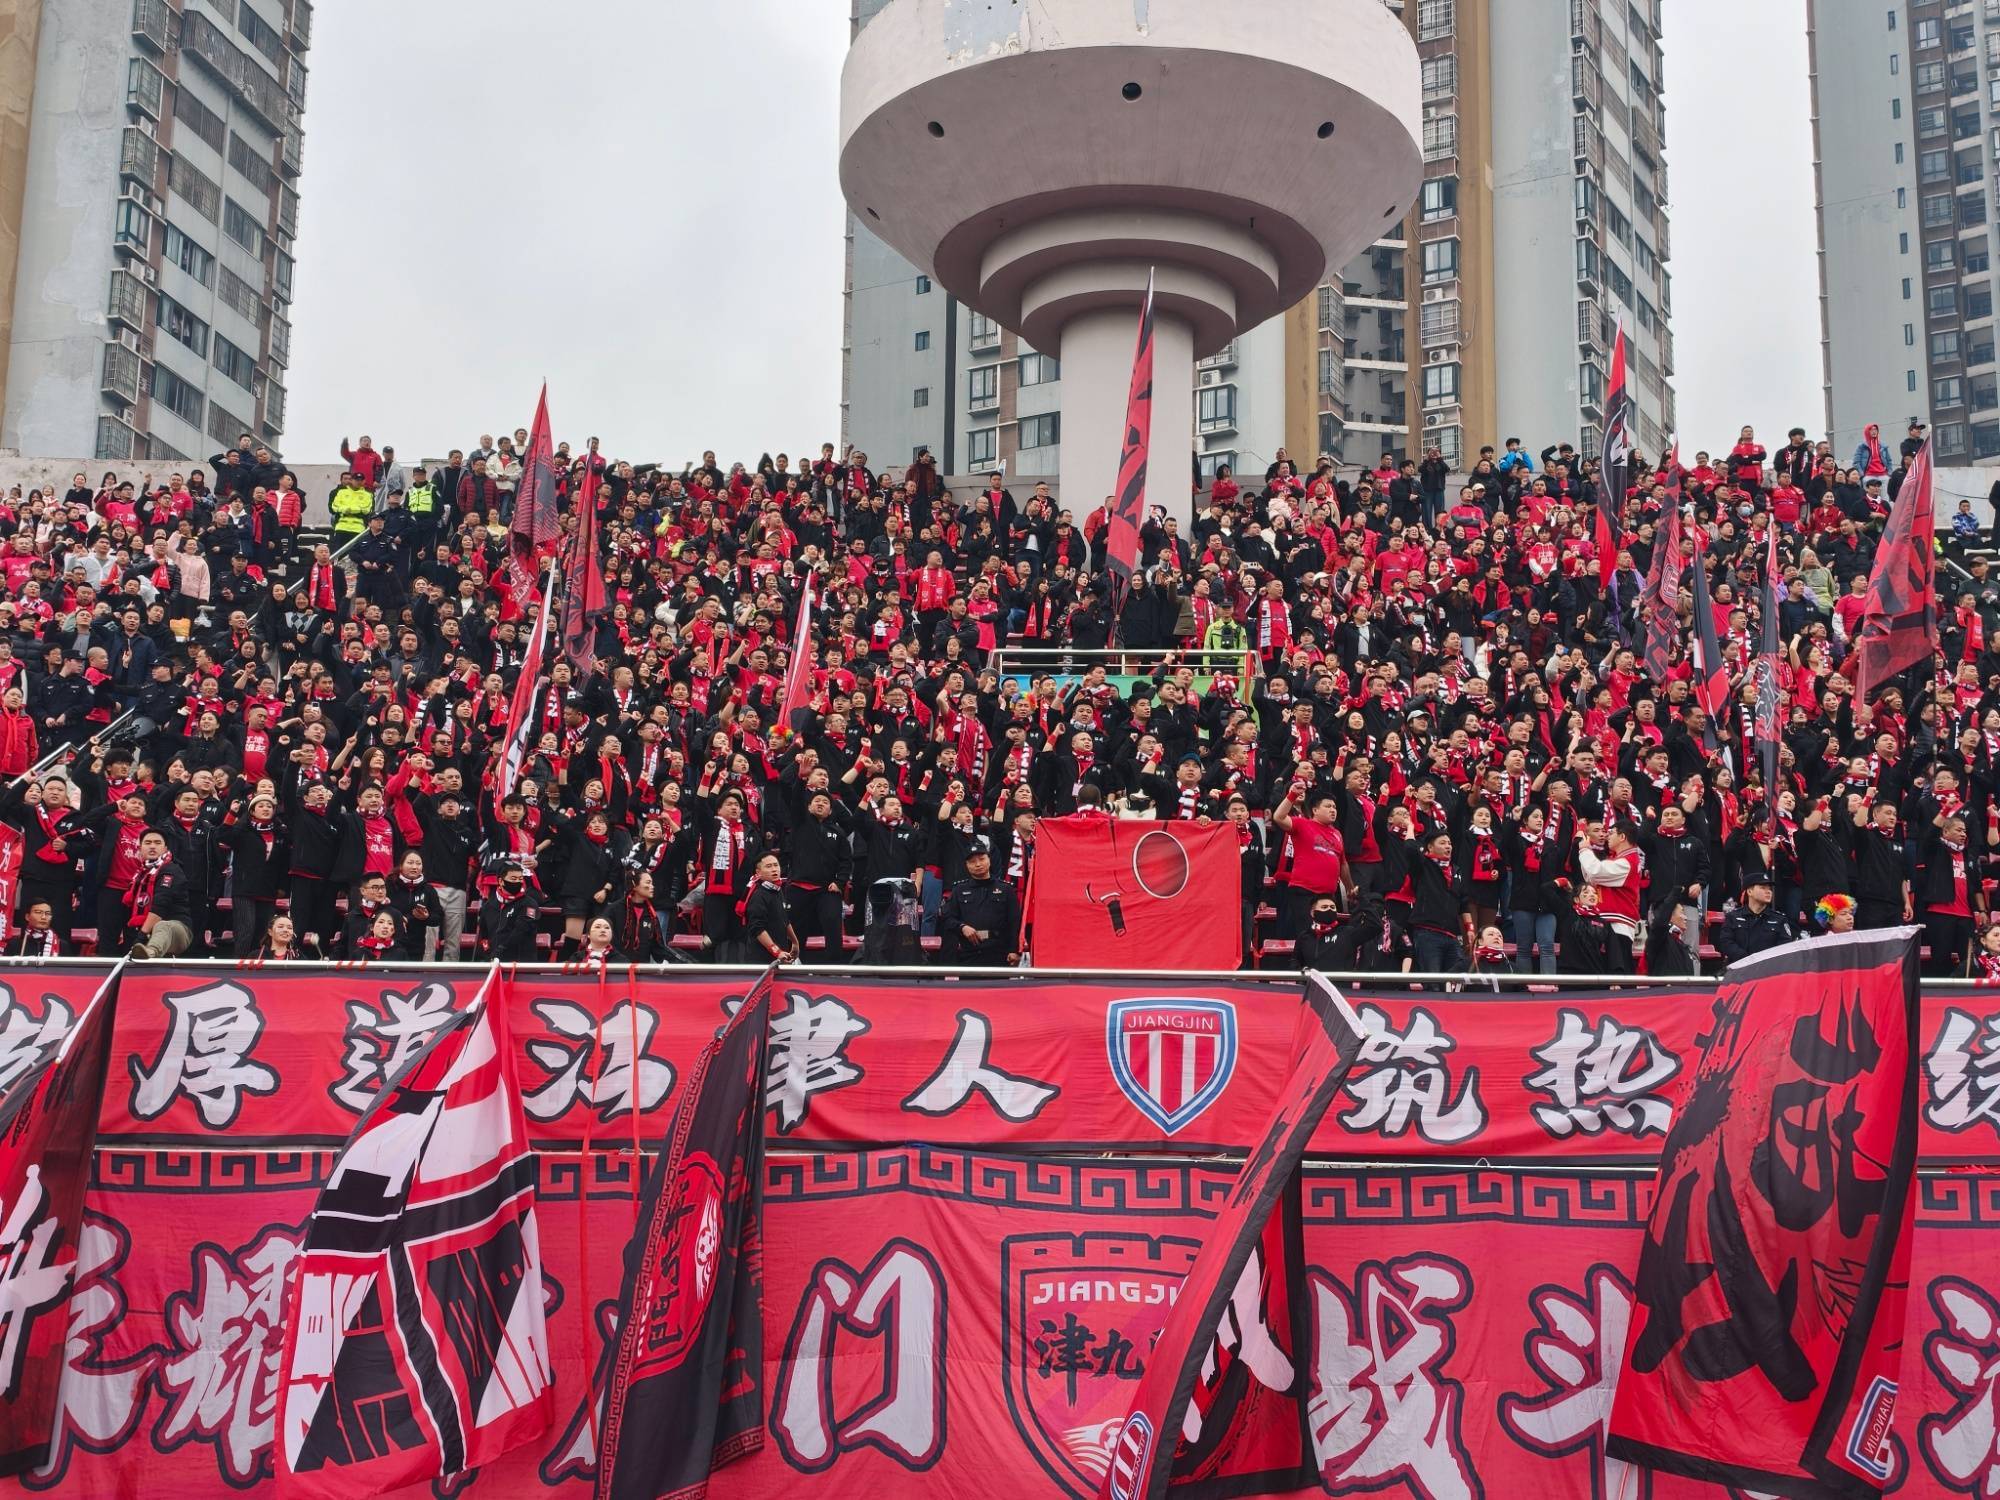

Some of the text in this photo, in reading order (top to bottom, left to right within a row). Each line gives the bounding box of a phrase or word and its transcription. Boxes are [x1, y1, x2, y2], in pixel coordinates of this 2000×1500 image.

[1128, 1015, 1214, 1031] JIANGJIN
[1033, 1281, 1178, 1306] JIANGJI
[1034, 1312, 1165, 1408] 津九
